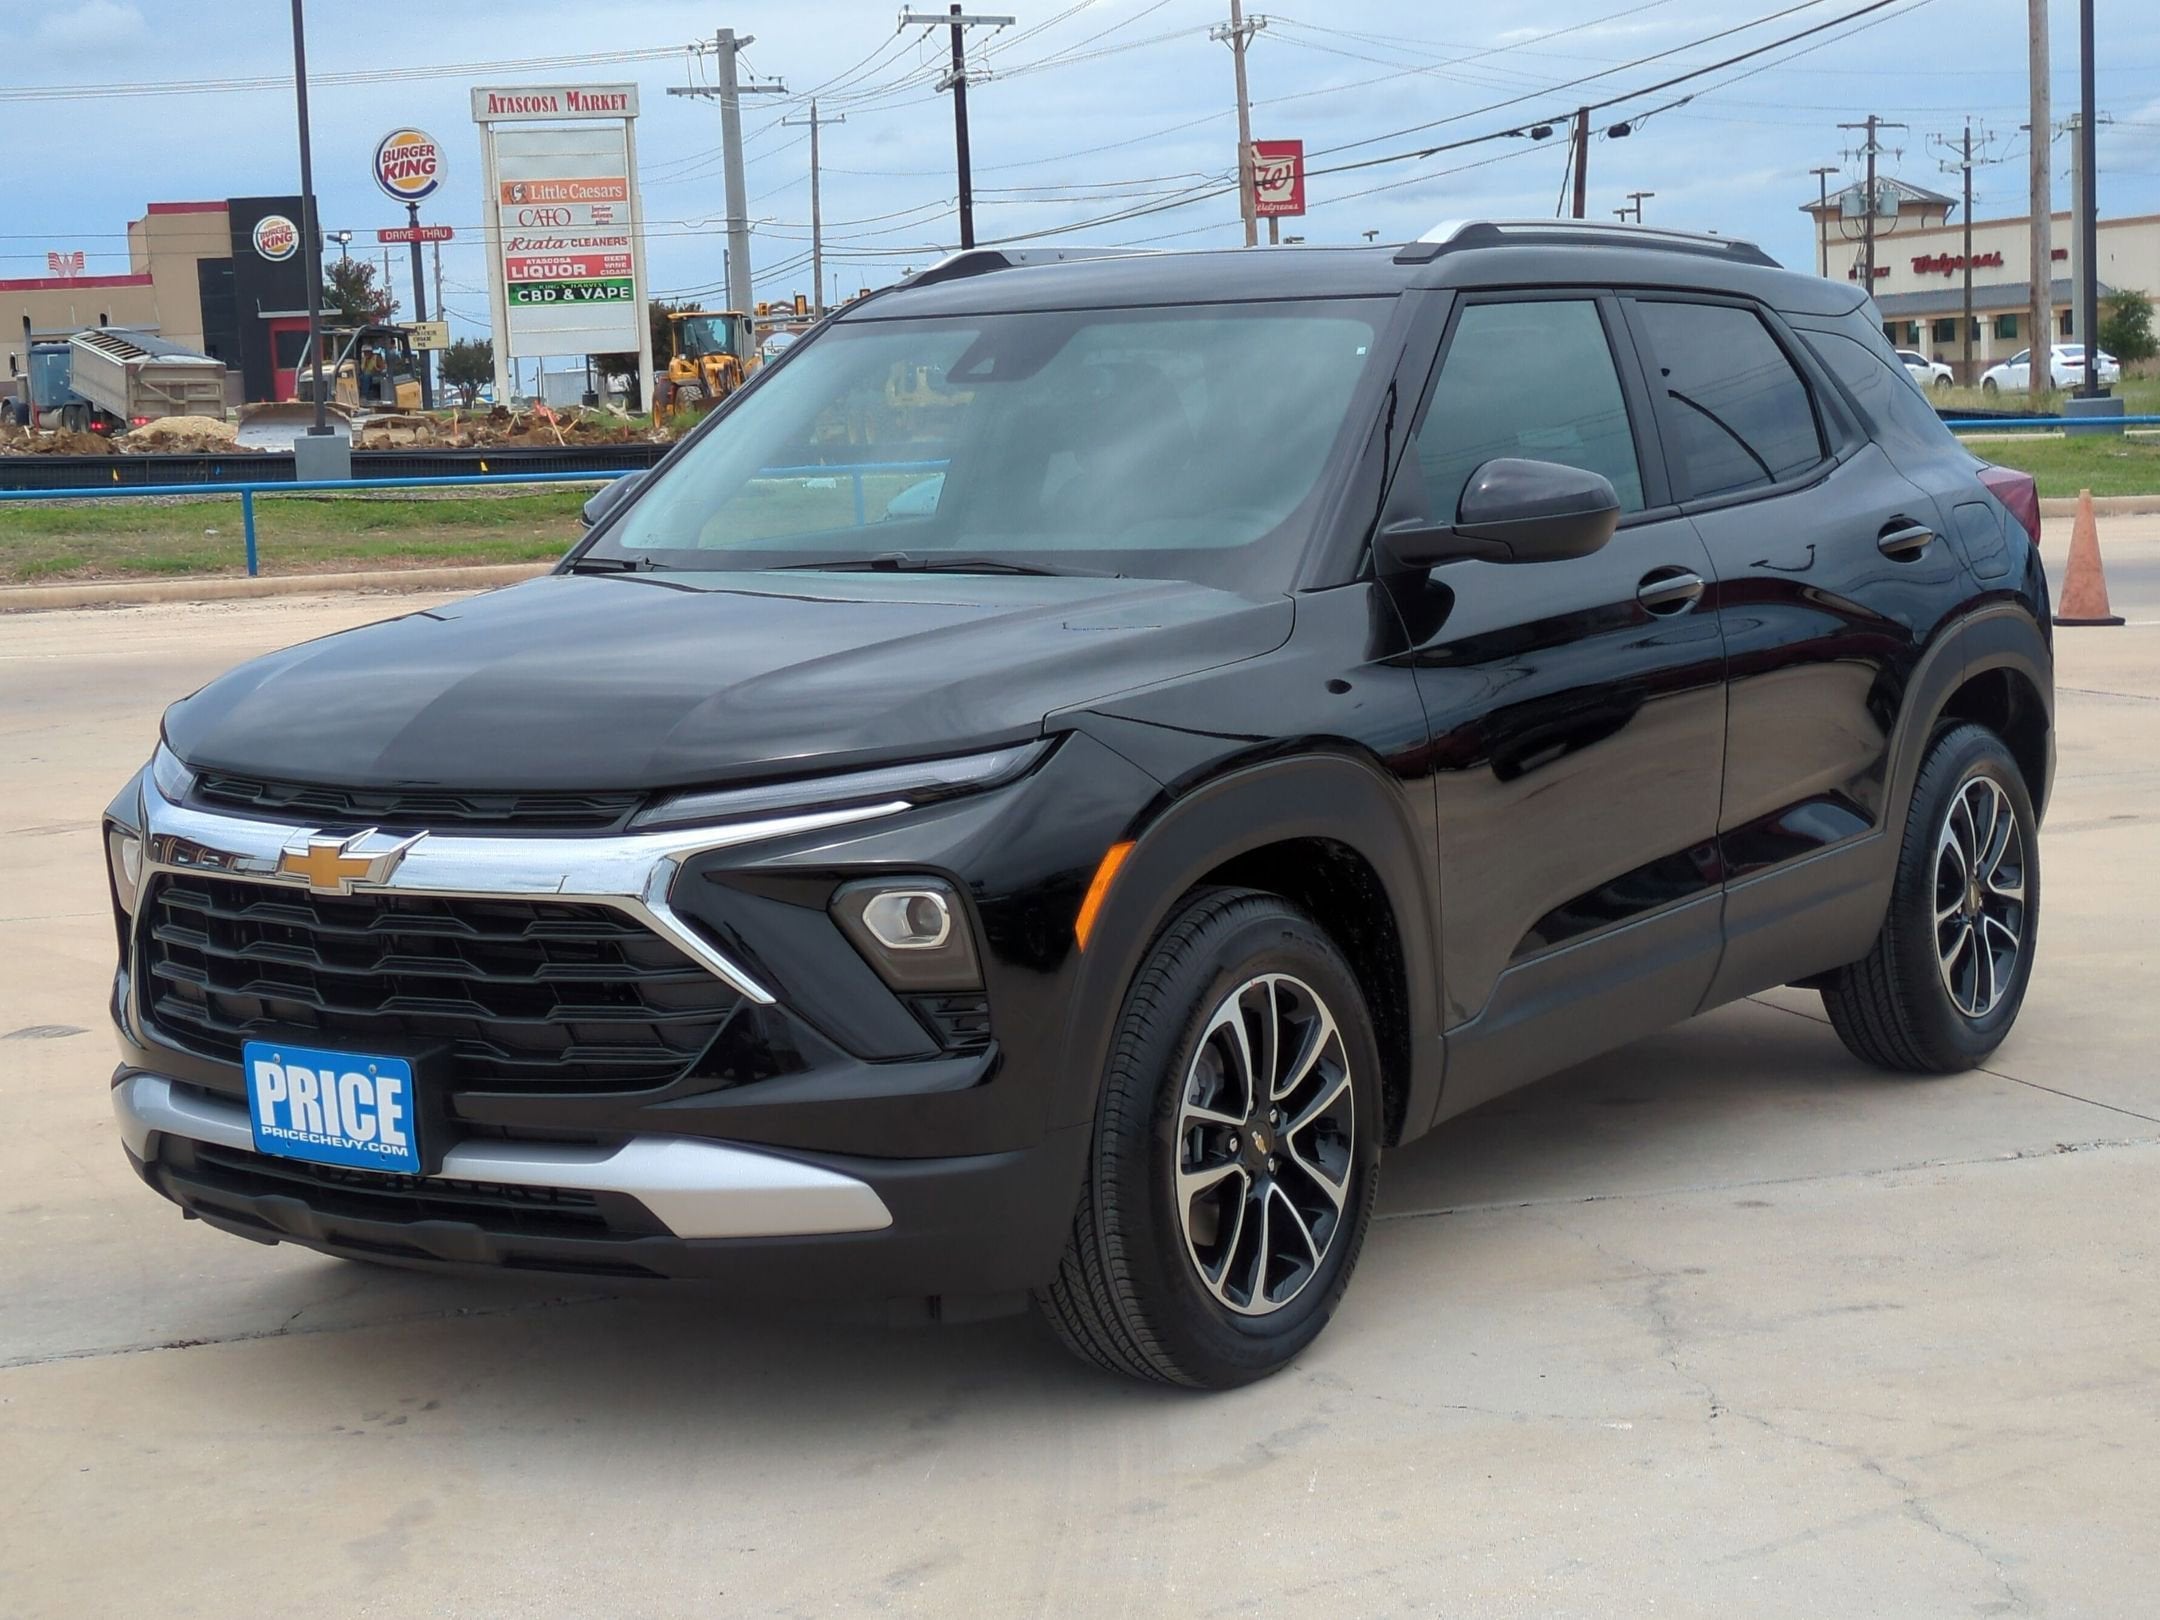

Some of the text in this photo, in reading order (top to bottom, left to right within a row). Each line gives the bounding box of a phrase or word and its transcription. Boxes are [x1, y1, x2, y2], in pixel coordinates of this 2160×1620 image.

[488, 91, 628, 114] ATASCOSA MARKET
[382, 144, 435, 164] BURGER
[383, 157, 437, 183] KING
[531, 183, 623, 200] Little Caesars
[518, 207, 572, 227] CATO
[262, 231, 293, 250] KING
[385, 228, 448, 241] DRIVE THRU
[571, 236, 629, 247] CLEANERS
[511, 264, 587, 278] LIQUOR
[518, 286, 630, 302] CBD & VAPE
[253, 1060, 407, 1146] PRICE
[261, 1125, 409, 1157] PRICECHEVY.COM
